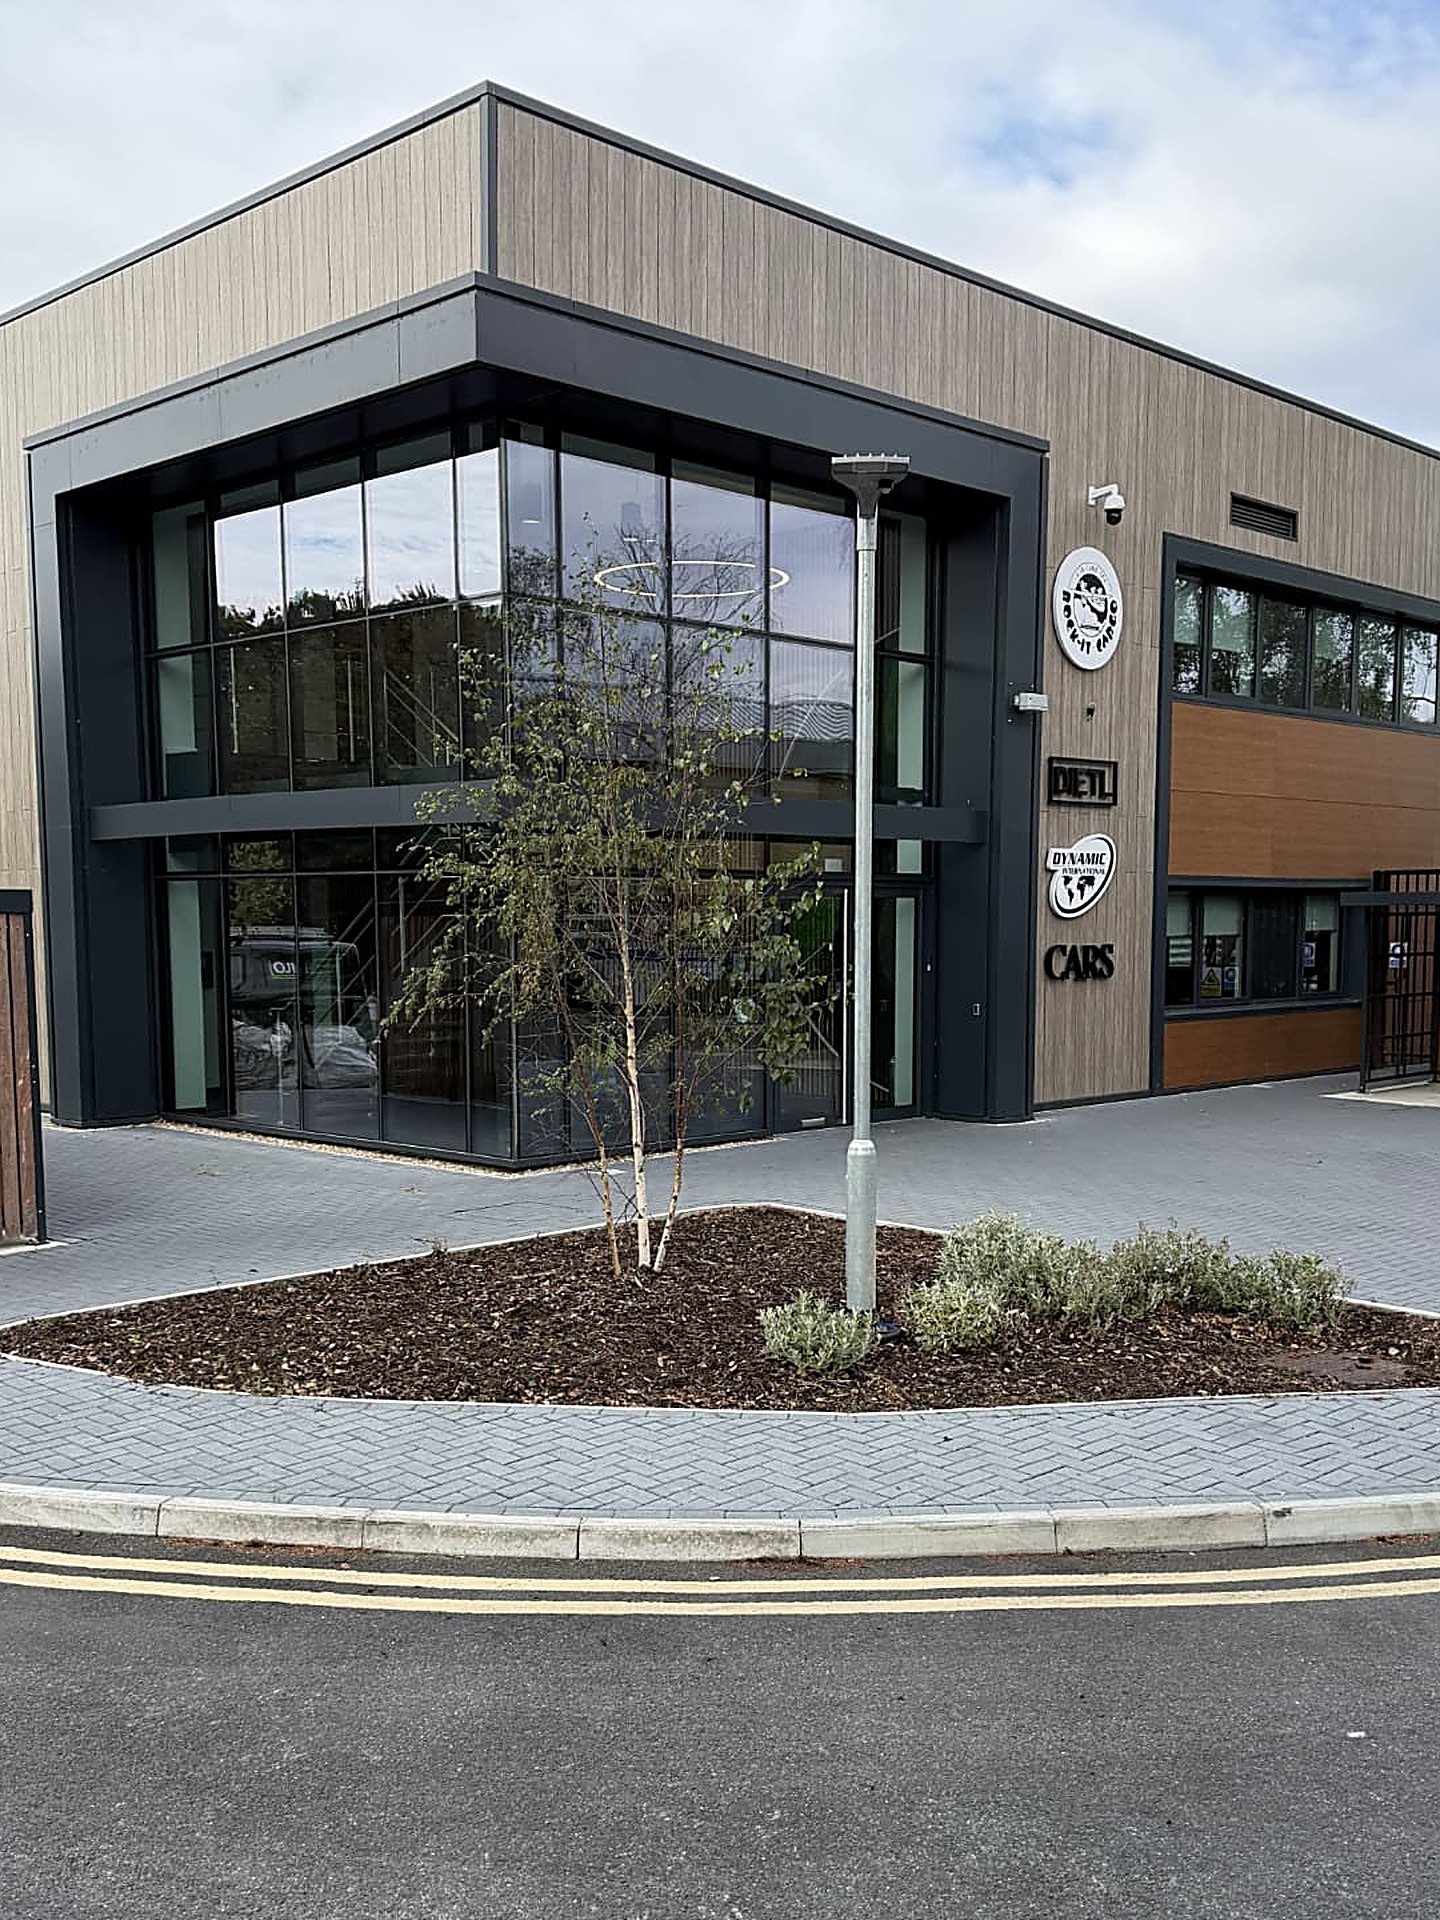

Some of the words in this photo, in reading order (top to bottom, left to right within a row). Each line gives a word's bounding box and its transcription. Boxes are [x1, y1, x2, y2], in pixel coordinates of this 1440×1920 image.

[1062, 590, 1091, 655] ROCK-IT
[1096, 600, 1118, 653] CARGO
[1053, 767, 1113, 799] DIETL
[1052, 852, 1107, 865] DYNAMIC
[1044, 944, 1114, 981] CARS
